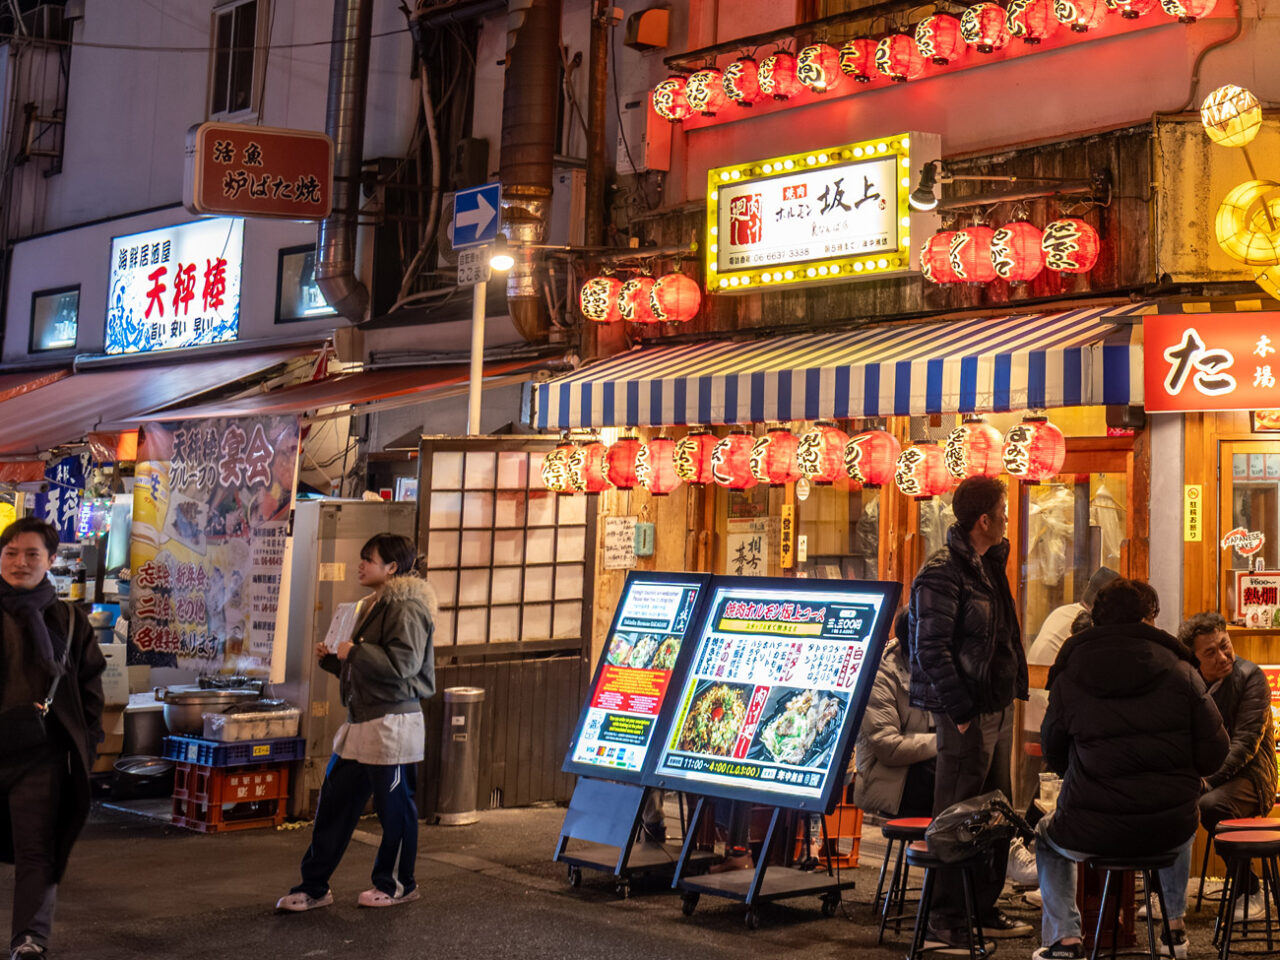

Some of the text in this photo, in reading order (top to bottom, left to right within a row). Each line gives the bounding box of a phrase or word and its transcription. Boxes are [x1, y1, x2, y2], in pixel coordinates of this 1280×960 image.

[213, 140, 265, 168] 活魚
[221, 171, 323, 204] 炉ばた焼
[818, 176, 881, 216] 坂上
[775, 204, 813, 223] ホルモン
[118, 239, 172, 270] 海鮮居酒屋
[170, 320, 187, 338] 安い
[218, 423, 275, 488] 宴会
[150, 474, 161, 502] 生
[169, 462, 217, 489] グループの
[782, 517, 792, 556] 営業中
[747, 535, 763, 571] 相方
[1243, 586, 1278, 606] 熱燗
[722, 600, 827, 623] 焼肉ホルモン坂上コース
